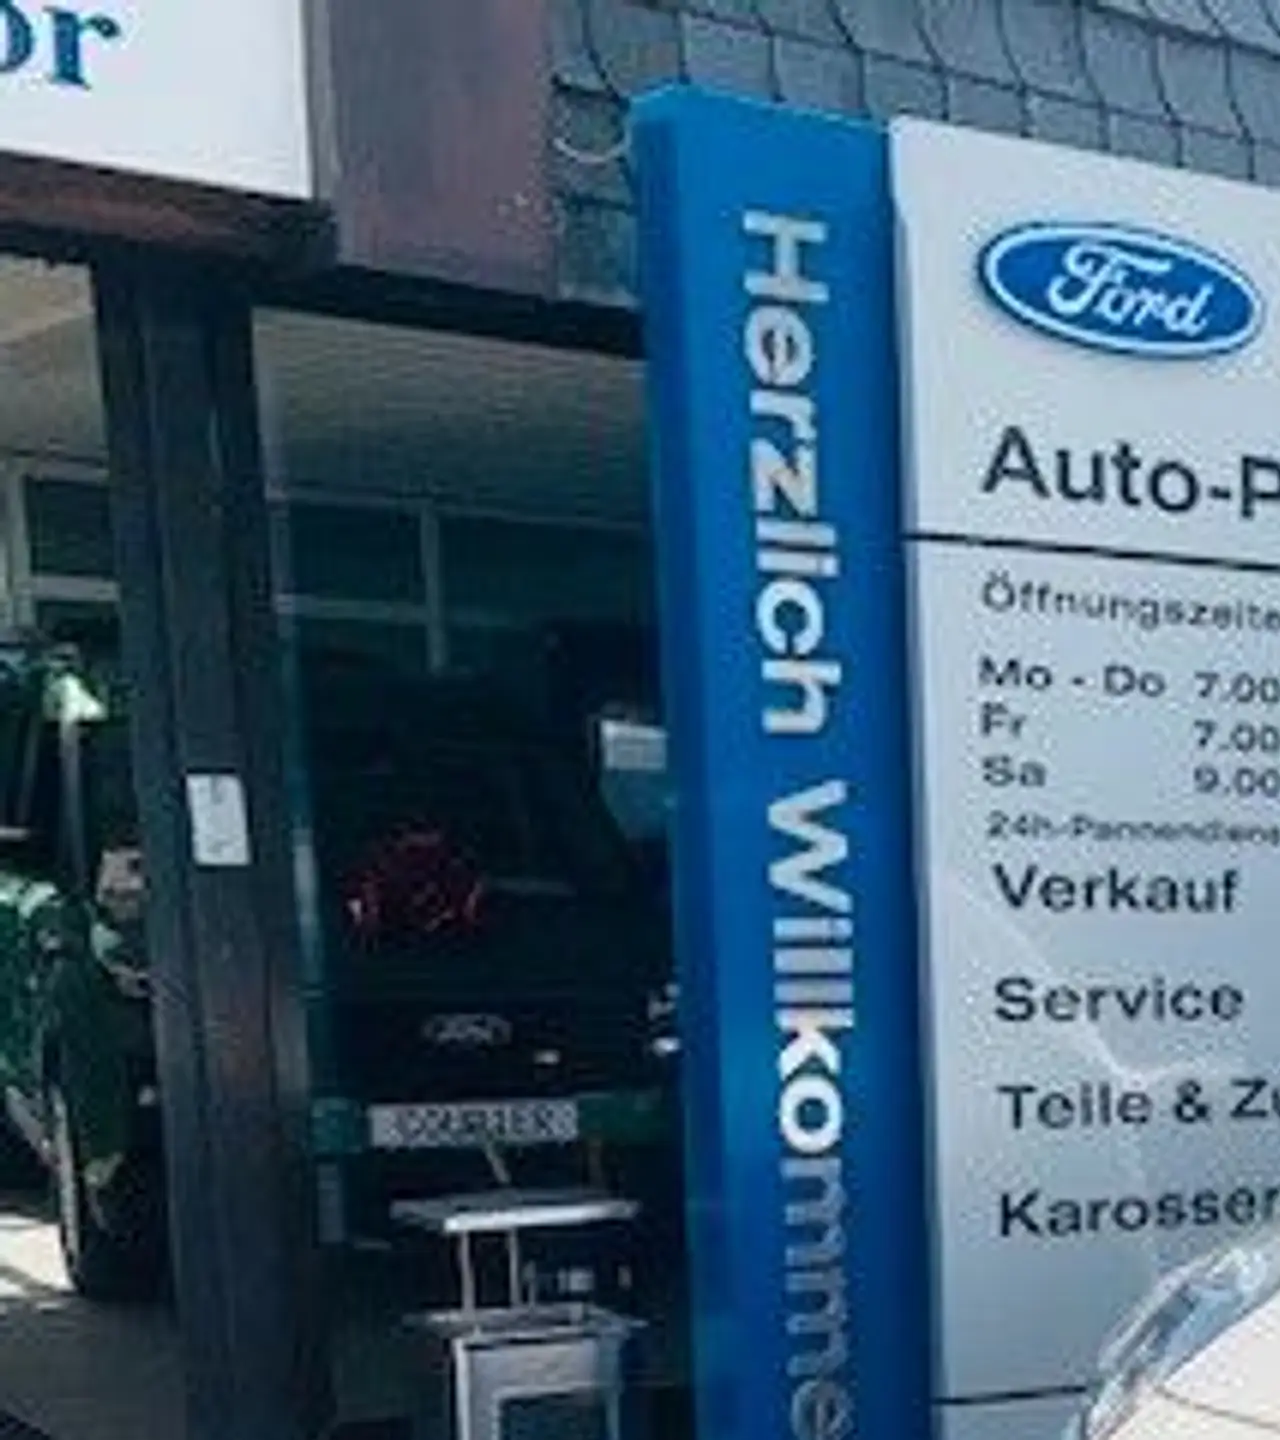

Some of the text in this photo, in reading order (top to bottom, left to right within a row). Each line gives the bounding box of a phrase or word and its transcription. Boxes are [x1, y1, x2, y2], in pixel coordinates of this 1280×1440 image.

[1047, 240, 1218, 338] Ford
[742, 210, 842, 735] Herzlich
[979, 655, 1053, 692] Mo
[1103, 663, 1167, 698] Do
[980, 701, 1027, 738] Fr
[982, 754, 1047, 788] Sa
[993, 862, 1241, 914] Verkauf
[994, 975, 1246, 1023] Service
[998, 1083, 1153, 1131] Teile
[1174, 1078, 1211, 1124] &
